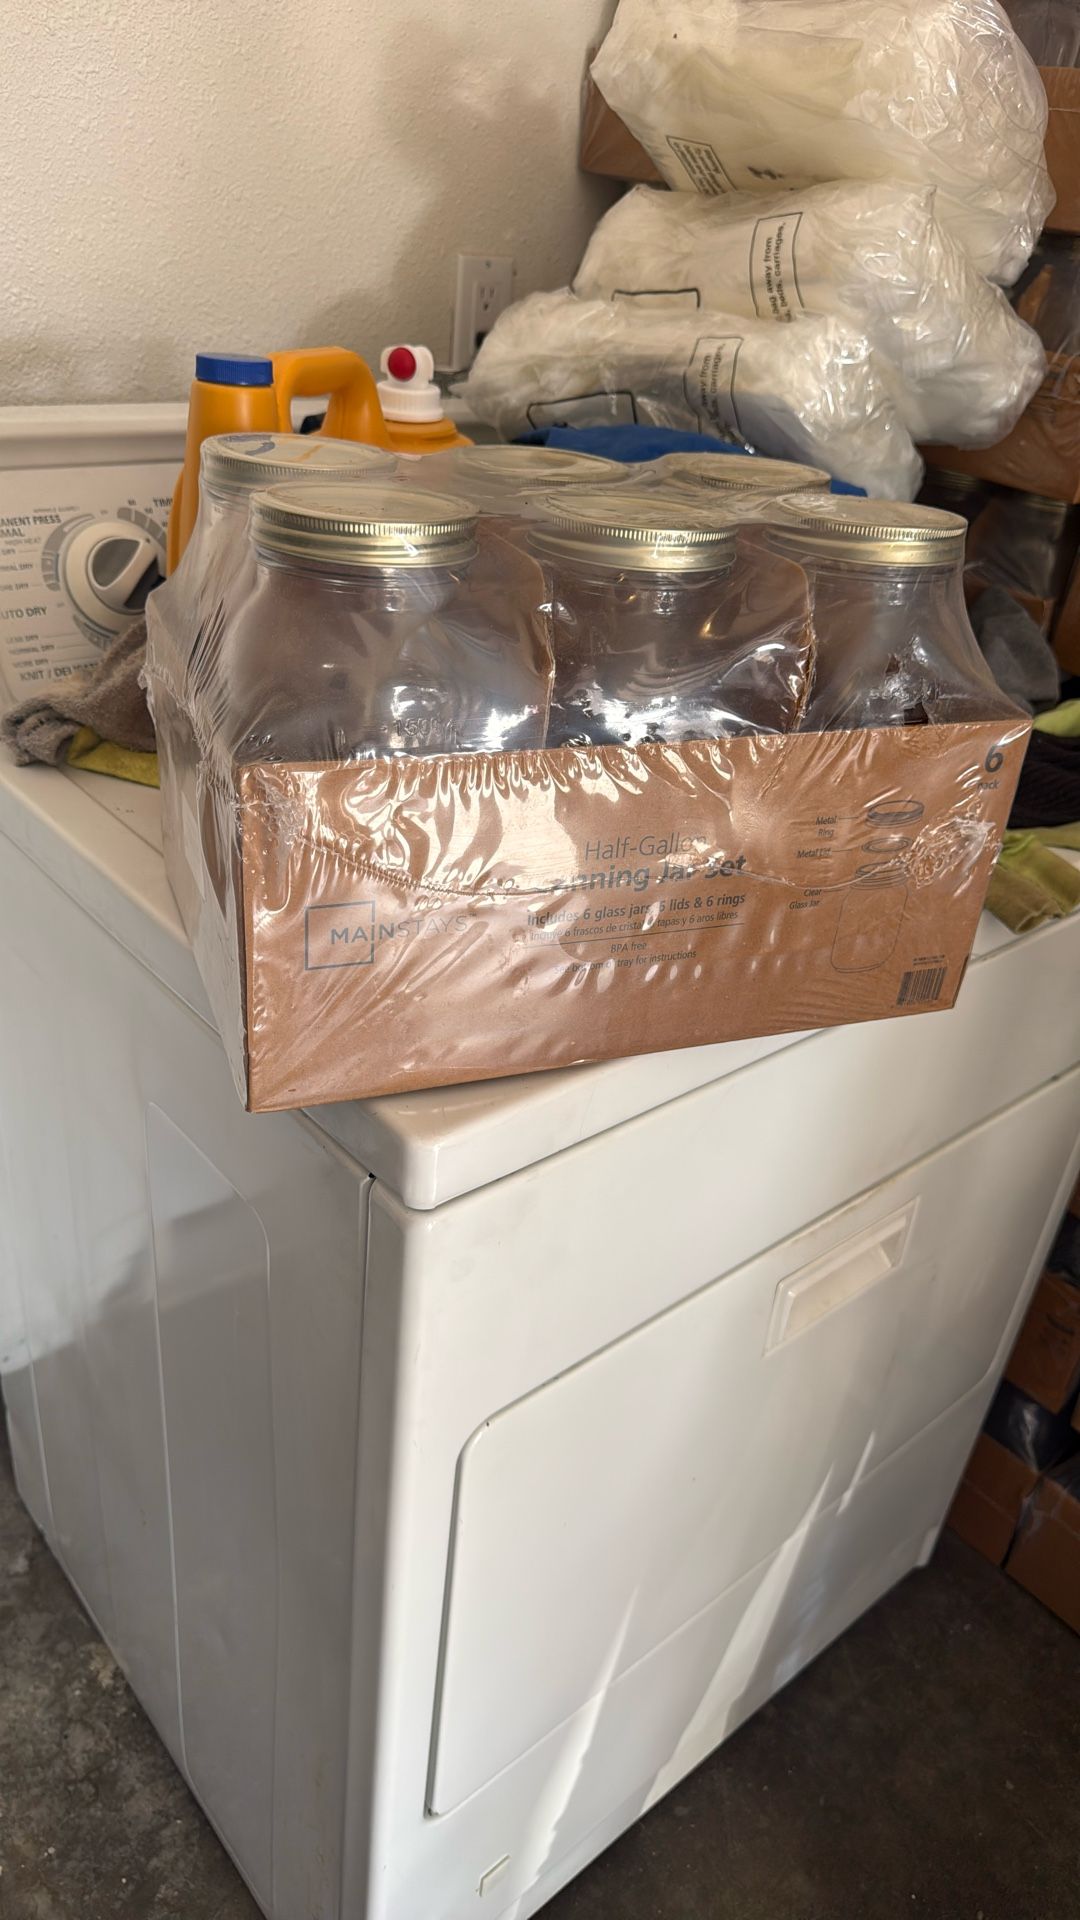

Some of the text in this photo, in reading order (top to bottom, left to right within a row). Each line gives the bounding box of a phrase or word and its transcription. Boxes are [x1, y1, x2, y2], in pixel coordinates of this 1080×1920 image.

[763, 236, 773, 262] from
[764, 265, 774, 294] away
[699, 353, 712, 378] from
[32, 514, 61, 525] PRESS
[25, 606, 47, 617] DRY
[19, 670, 44, 681] KNIT
[985, 744, 1004, 773] 6
[815, 815, 838, 826] Metal
[797, 848, 818, 858] Metal
[803, 888, 822, 898] Clear
[583, 908, 591, 920] 6
[595, 906, 626, 921] glass
[669, 898, 690, 912] lids
[693, 896, 703, 909] &
[706, 895, 714, 907] 6
[717, 893, 746, 908] rings
[789, 901, 808, 910] Glass
[573, 926, 604, 937] frascos
[605, 923, 617, 933] de
[689, 914, 695, 924] 6
[696, 914, 715, 924] aros
[716, 911, 739, 921] libres
[611, 944, 628, 953] BPA
[617, 958, 633, 969] tray
[635, 954, 648, 964] for
[650, 950, 697, 962] instructions
